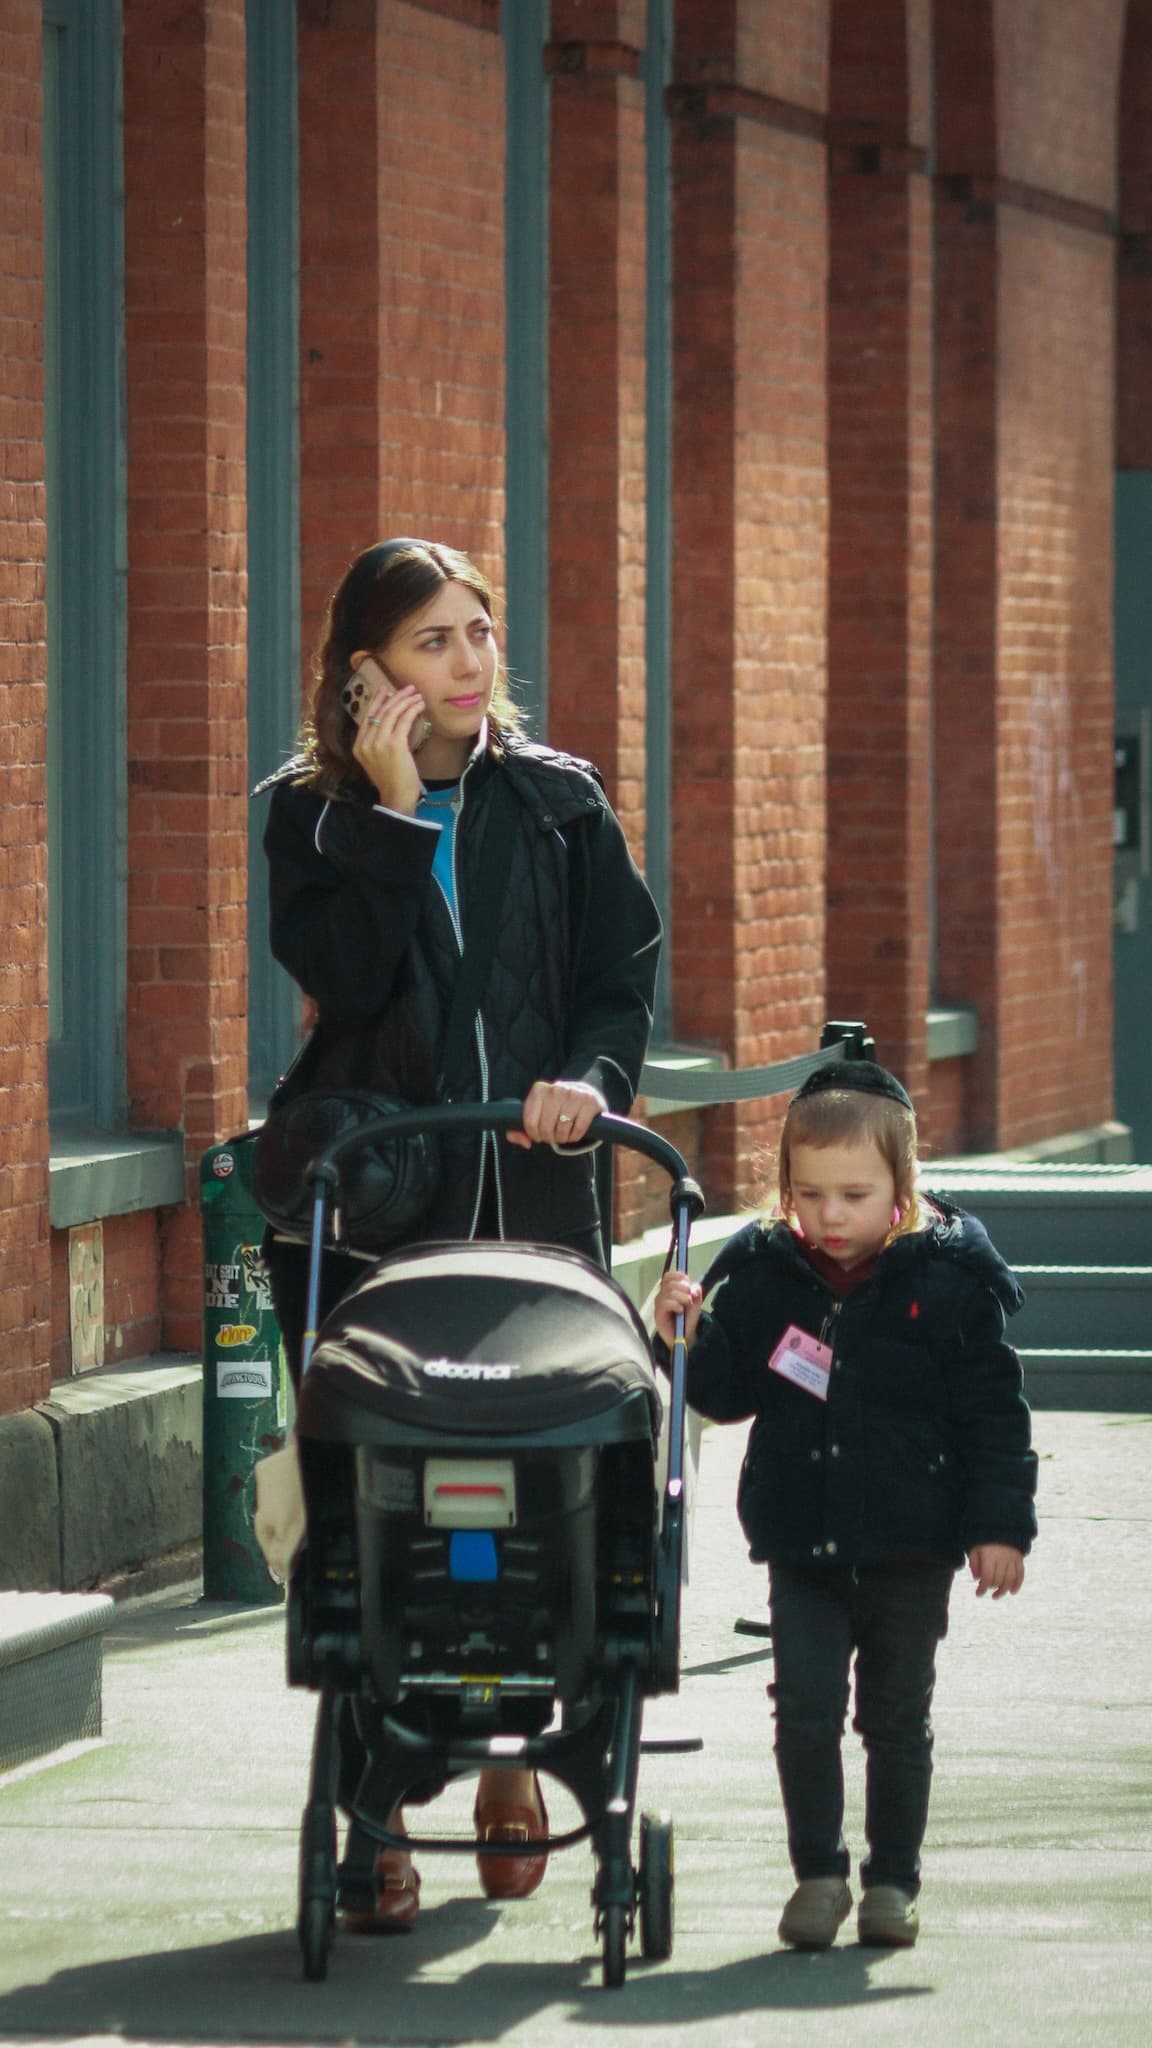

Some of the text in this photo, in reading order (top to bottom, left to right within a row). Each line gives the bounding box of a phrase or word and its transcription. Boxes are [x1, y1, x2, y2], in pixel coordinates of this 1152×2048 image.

[220, 1265, 240, 1280] SHIT
[212, 1279, 229, 1293] N
[205, 1293, 239, 1309] DIE
[424, 1358, 511, 1380] doona
